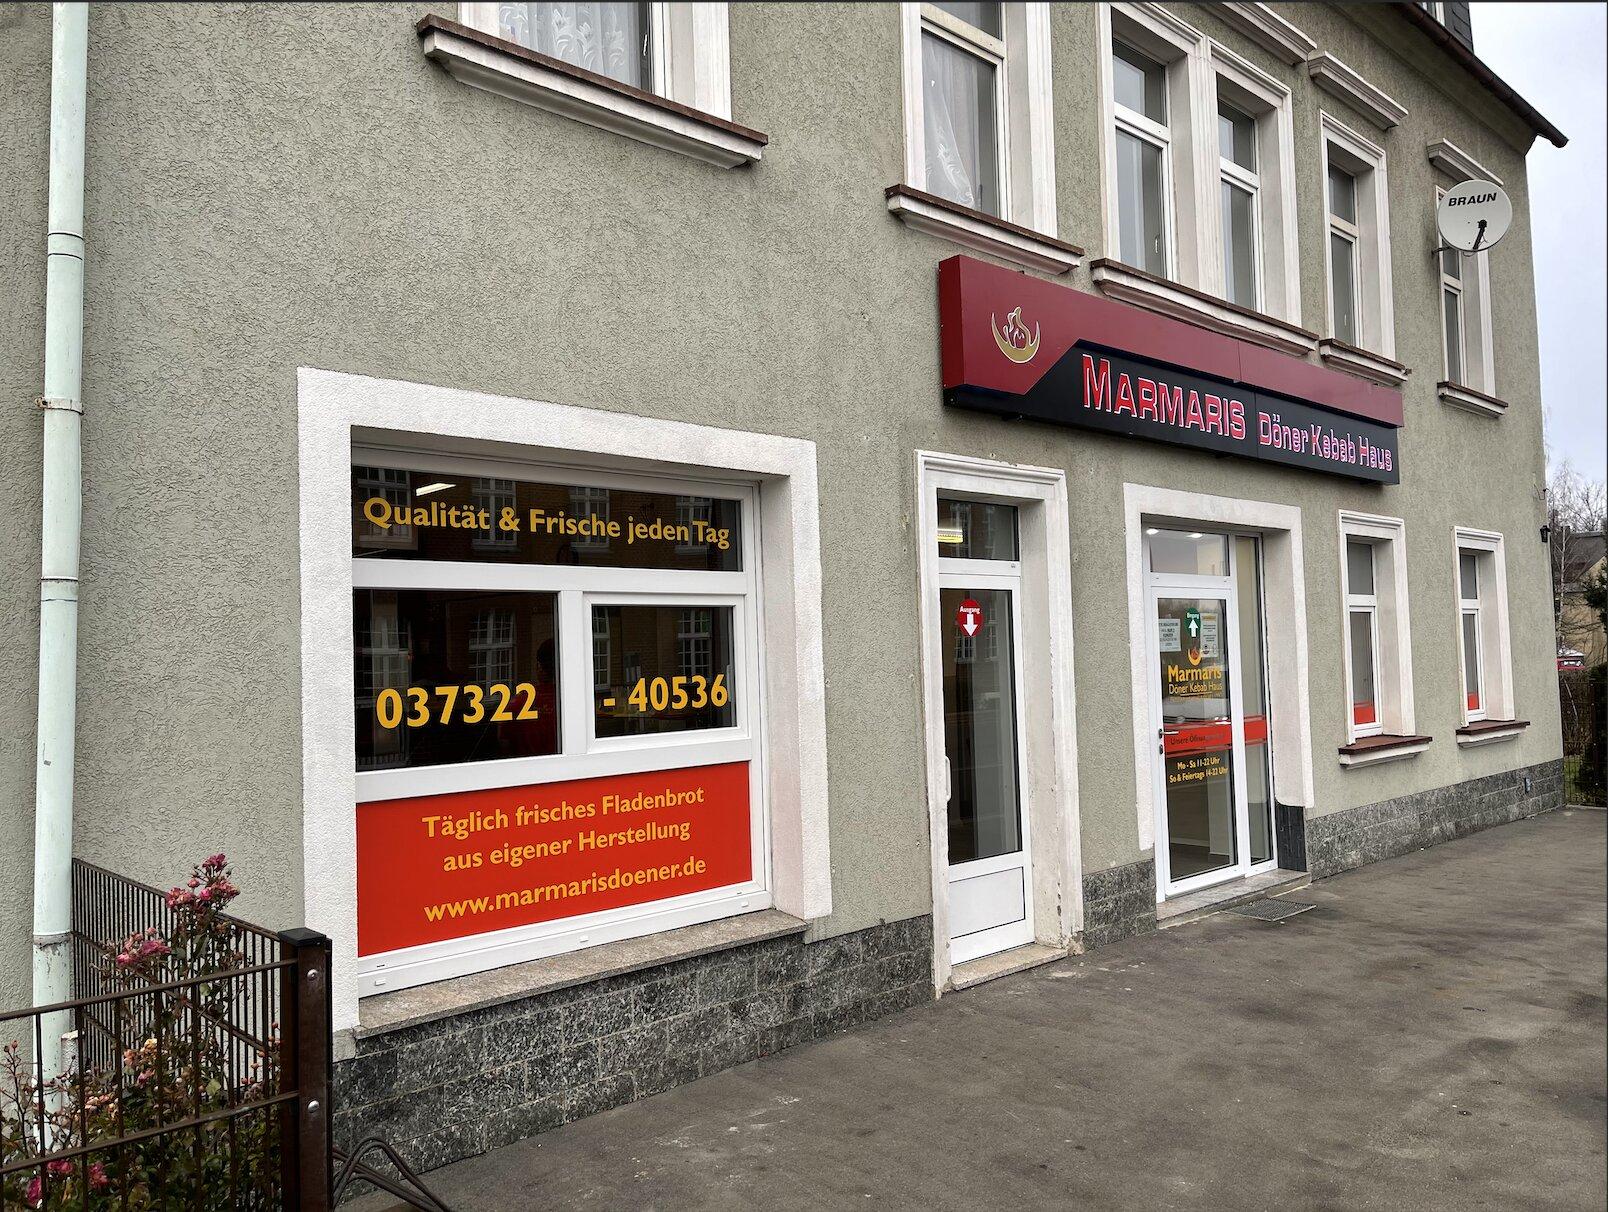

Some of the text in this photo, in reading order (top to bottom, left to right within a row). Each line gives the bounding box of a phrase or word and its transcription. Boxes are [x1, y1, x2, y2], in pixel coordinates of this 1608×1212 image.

[1448, 192, 1498, 207] BRAUN
[1257, 411, 1309, 454] Döner
[1310, 423, 1357, 465] Kebab
[1358, 435, 1394, 472] Haus
[363, 497, 731, 551] Qualität & Frische jeden Tag
[1167, 663, 1222, 683] Marmaris
[1168, 680, 1223, 695] Döner Kebab Haus
[375, 673, 728, 730] 037322 - 40536
[1169, 774, 1177, 784] So
[1182, 771, 1205, 782] Feiertags
[1218, 766, 1229, 775] Uhr
[1177, 761, 1186, 770] Mo
[1210, 756, 1221, 765] Uhr
[421, 786, 705, 841] Täglich frisches Fladenbrot
[443, 820, 691, 873] aus eigener Herstellung
[424, 855, 707, 923] www.marmarisdoener.de
